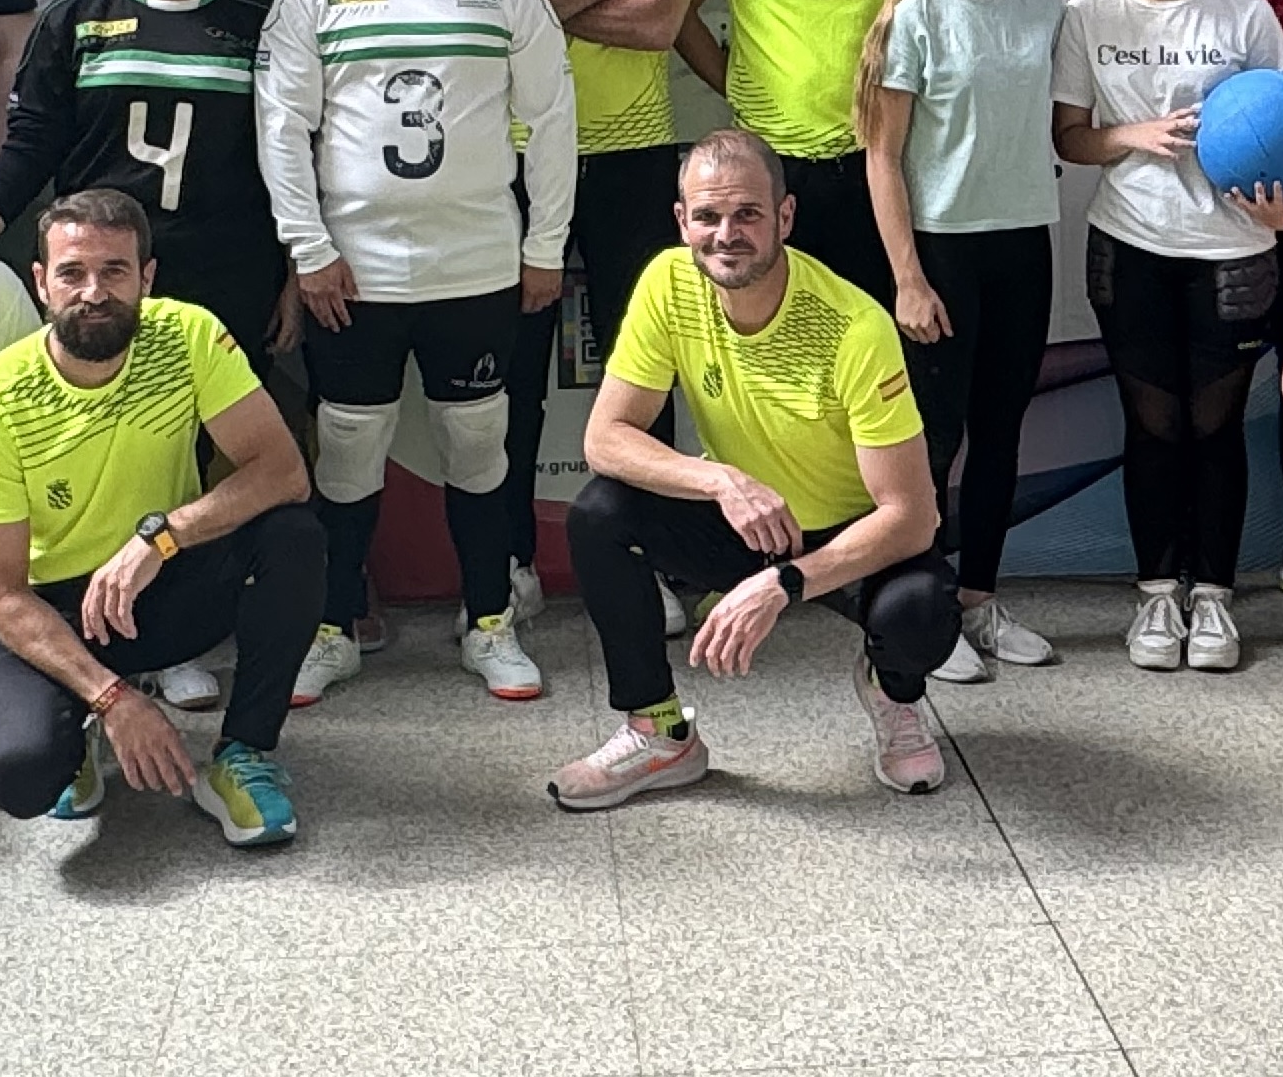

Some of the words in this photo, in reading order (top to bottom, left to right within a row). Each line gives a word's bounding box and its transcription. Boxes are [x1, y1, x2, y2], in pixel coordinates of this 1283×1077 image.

[1158, 44, 1180, 65] la
[1185, 44, 1227, 65] vie.
[127, 100, 194, 211] 4
[384, 69, 445, 180] 3
